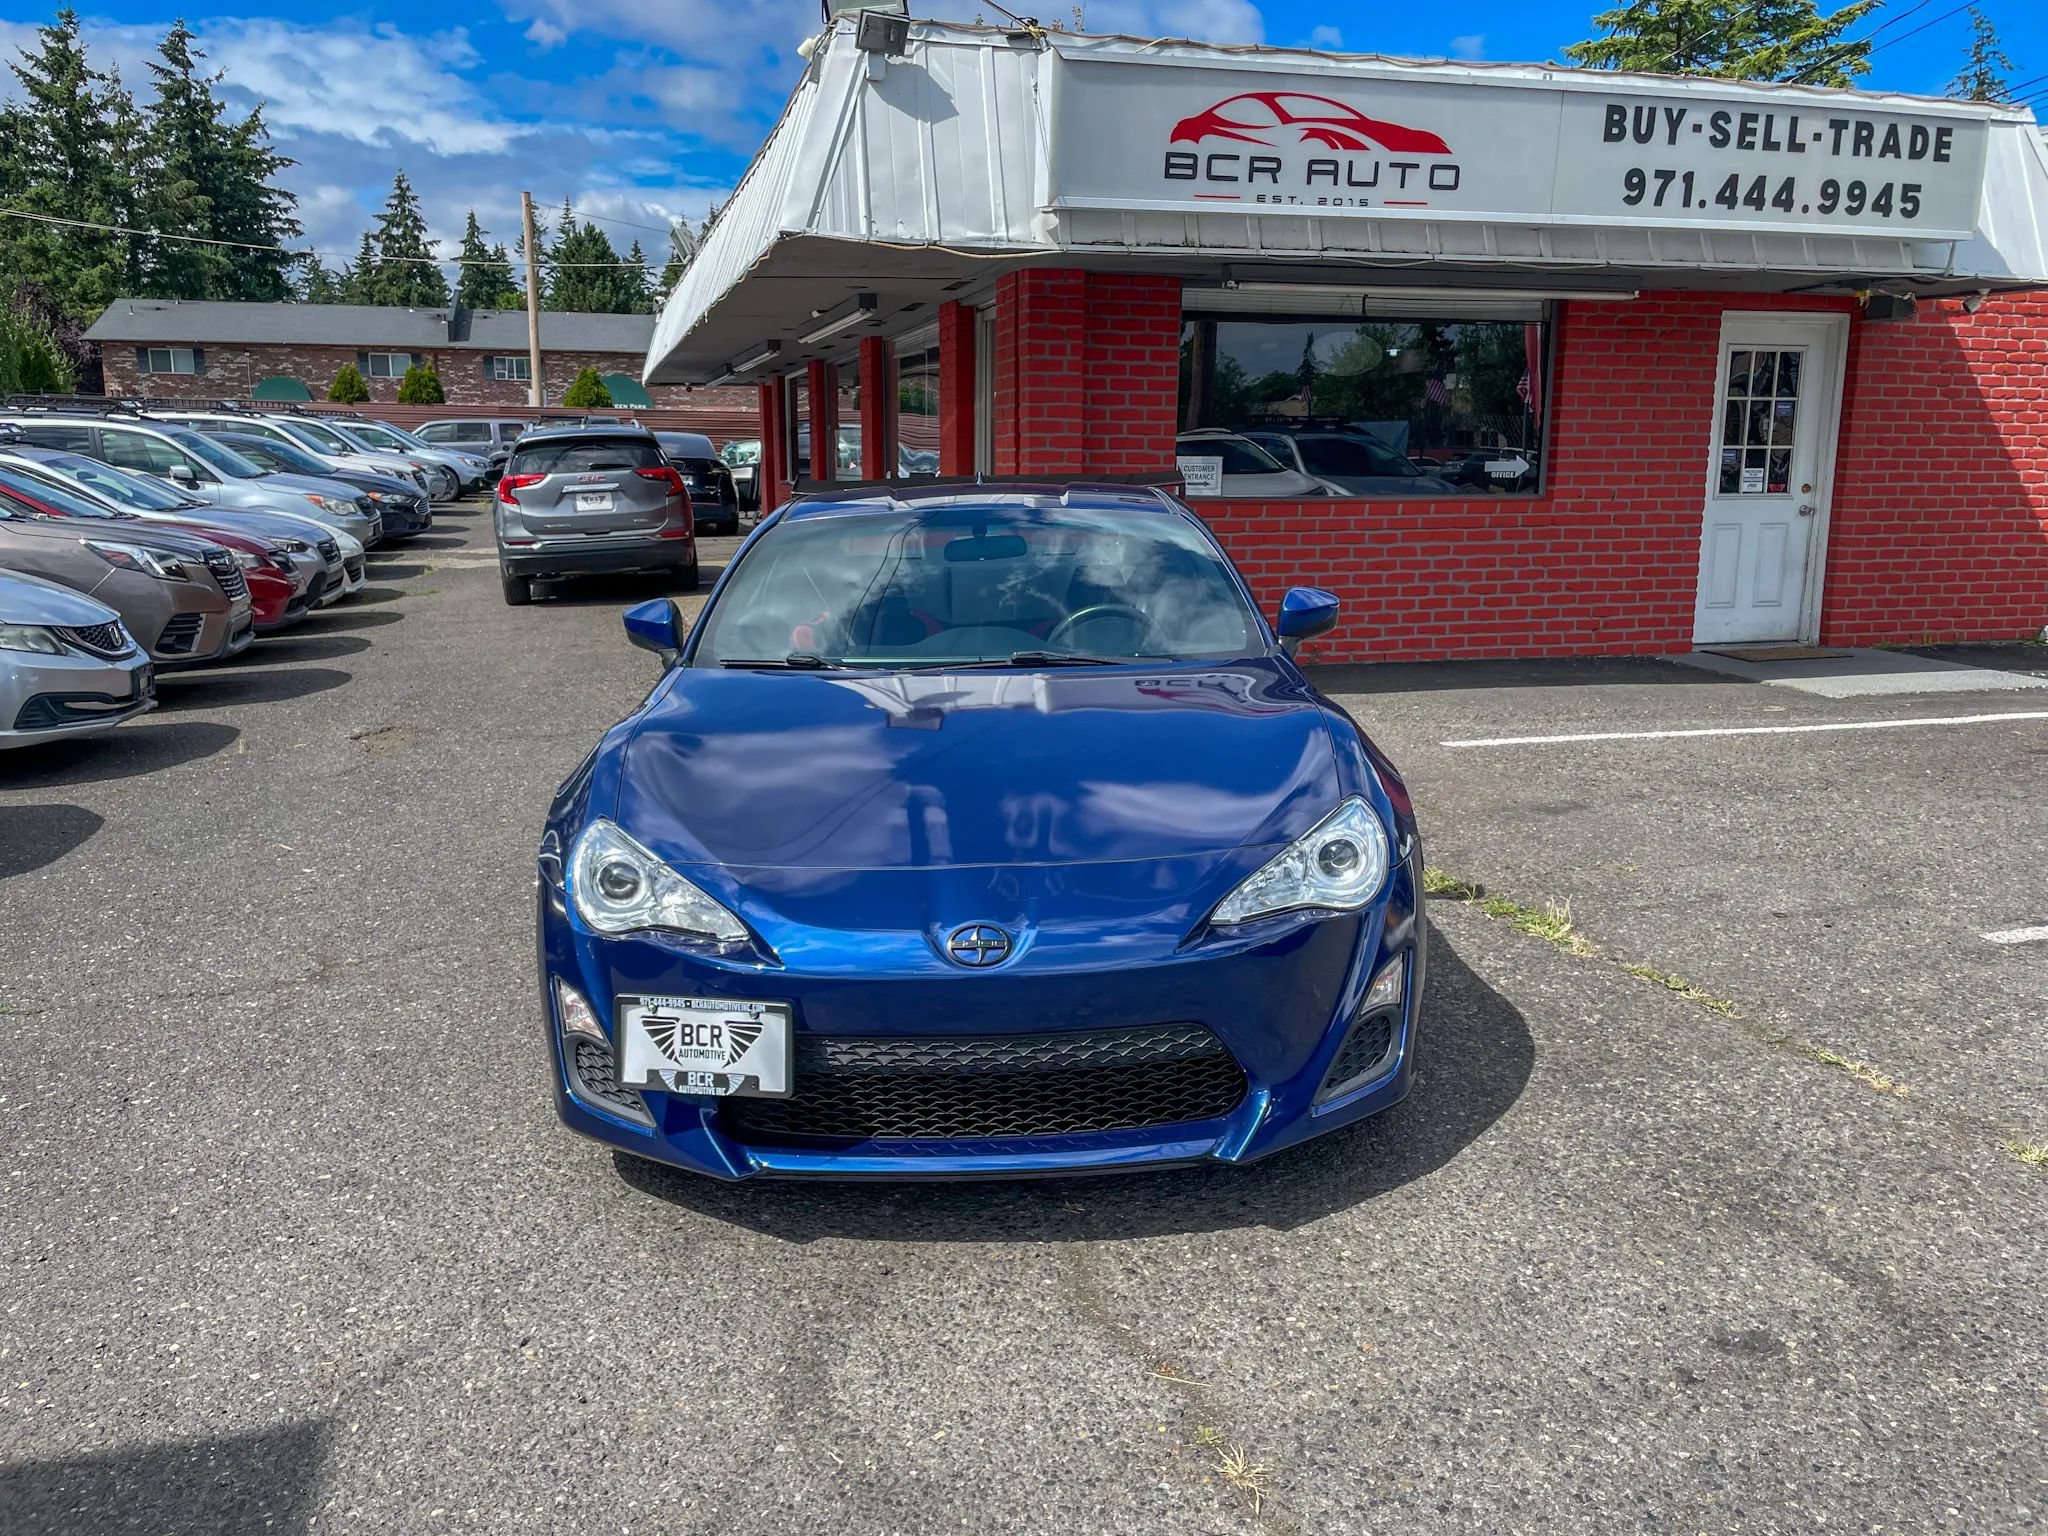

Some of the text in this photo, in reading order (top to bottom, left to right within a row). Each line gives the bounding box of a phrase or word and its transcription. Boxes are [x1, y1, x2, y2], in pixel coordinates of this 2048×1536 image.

[1163, 151, 1461, 191] BCR AUTO
[1622, 167, 1923, 219] 971.444.9945
[1256, 194, 1370, 208] EST. 2015
[1183, 465, 1216, 473] CUSTOMER
[1184, 473, 1216, 481] ENTRANCE
[681, 1023, 723, 1049] BCR
[678, 1048, 726, 1061] AUTOMOTIVE
[687, 1071, 714, 1088] BCR
[678, 1085, 716, 1096] AUTOMOTIVE
